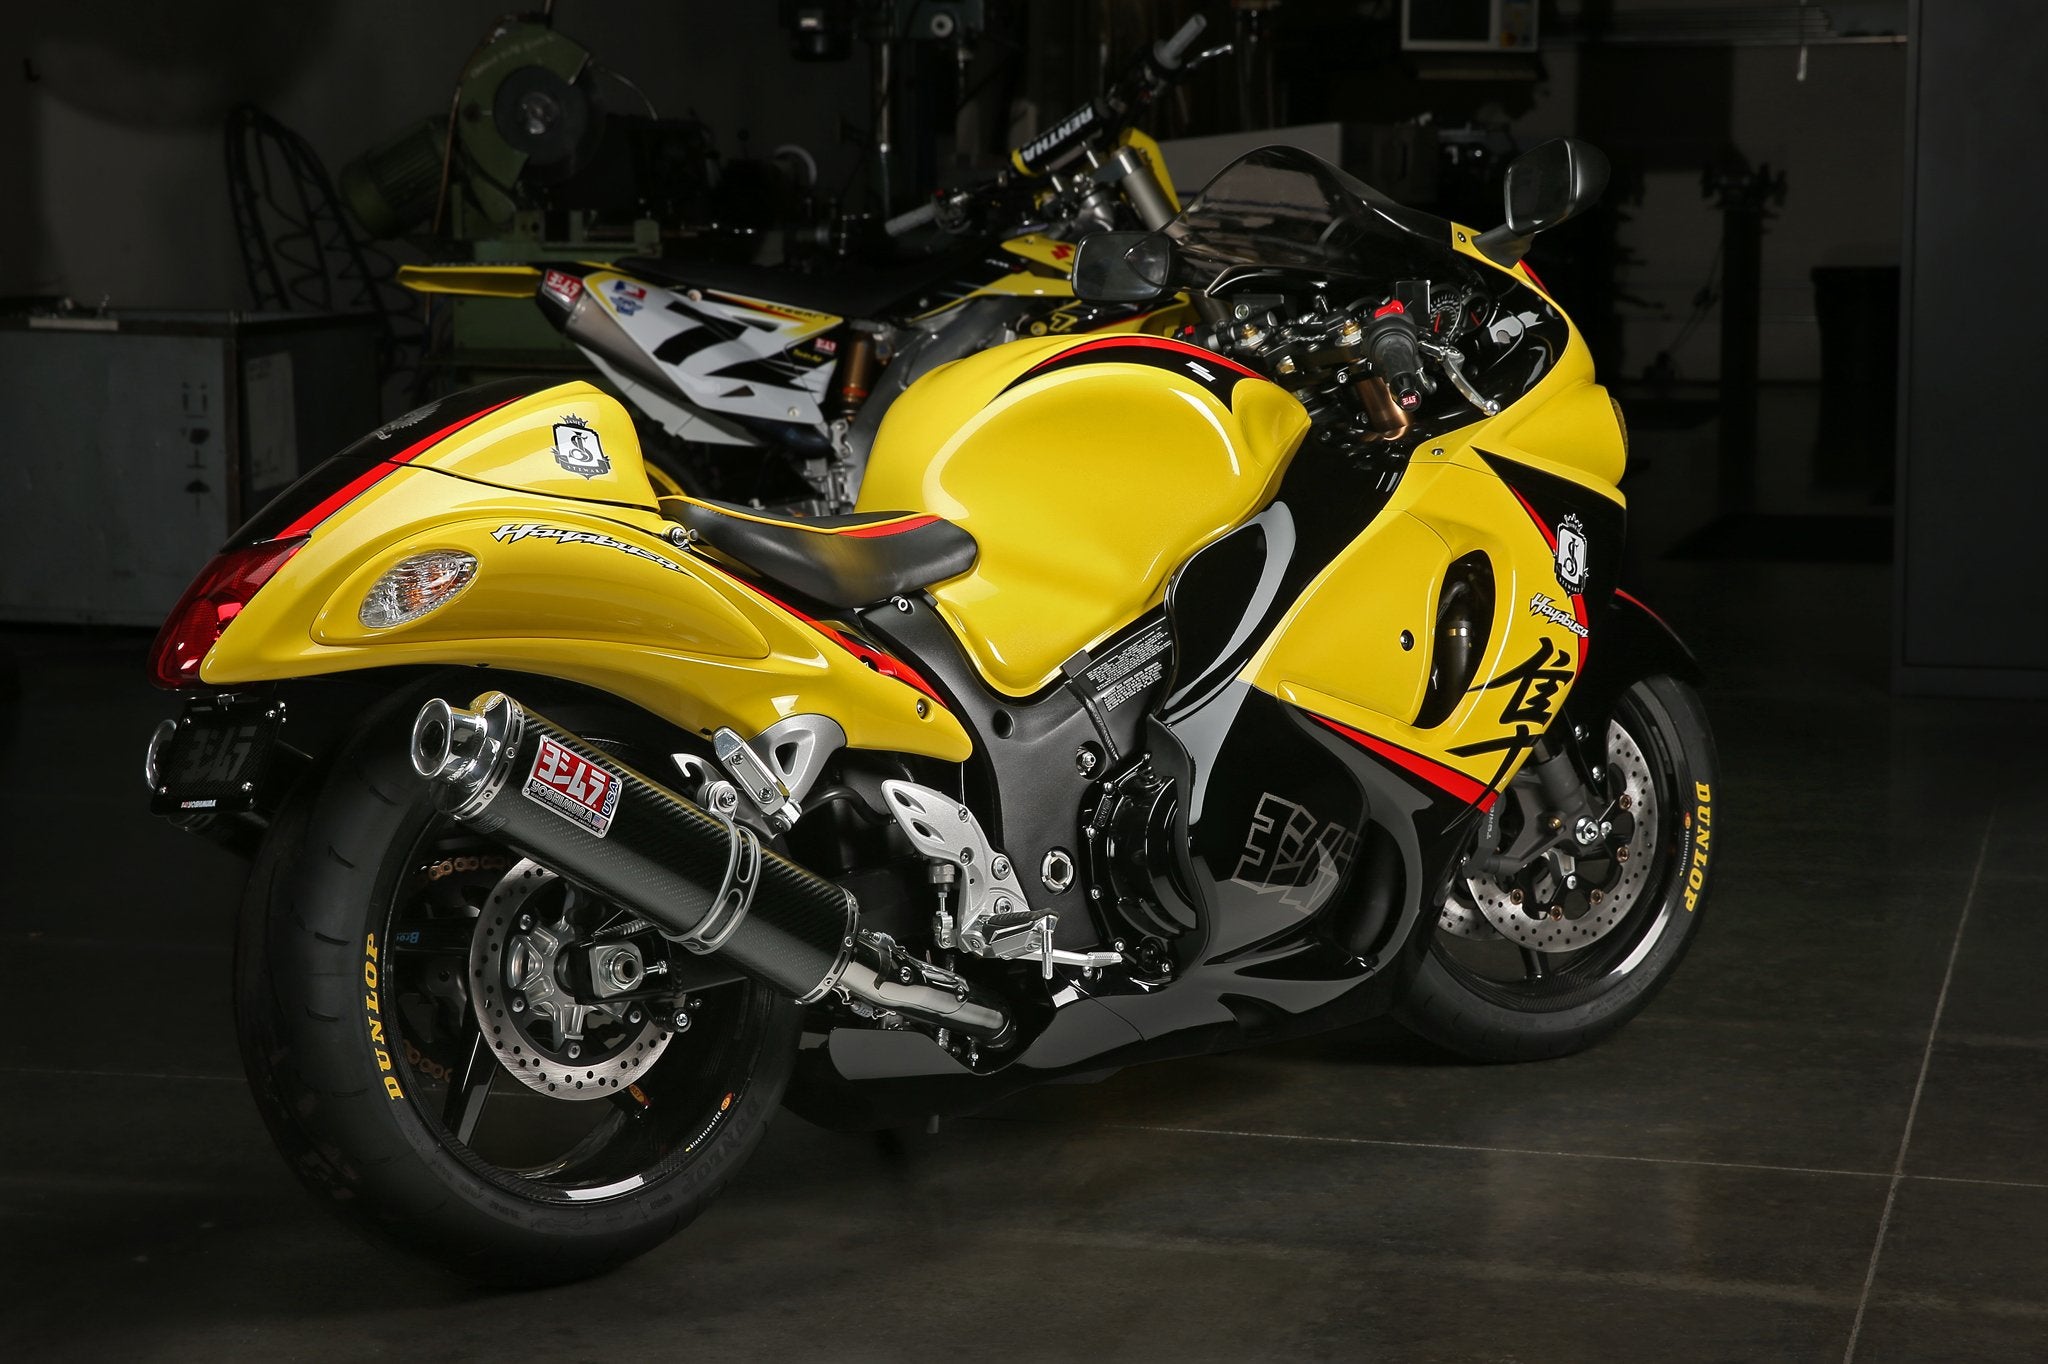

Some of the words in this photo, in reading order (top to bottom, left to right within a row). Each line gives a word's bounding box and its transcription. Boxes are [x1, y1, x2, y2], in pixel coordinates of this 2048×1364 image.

[1529, 592, 1589, 638] Hayabusa
[530, 780, 593, 823] YOSHIMURA
[537, 742, 606, 806] ヨシムラ
[601, 781, 619, 816] USA
[1684, 781, 1712, 912] DUNLOP
[364, 932, 405, 1100] DUNLOP
